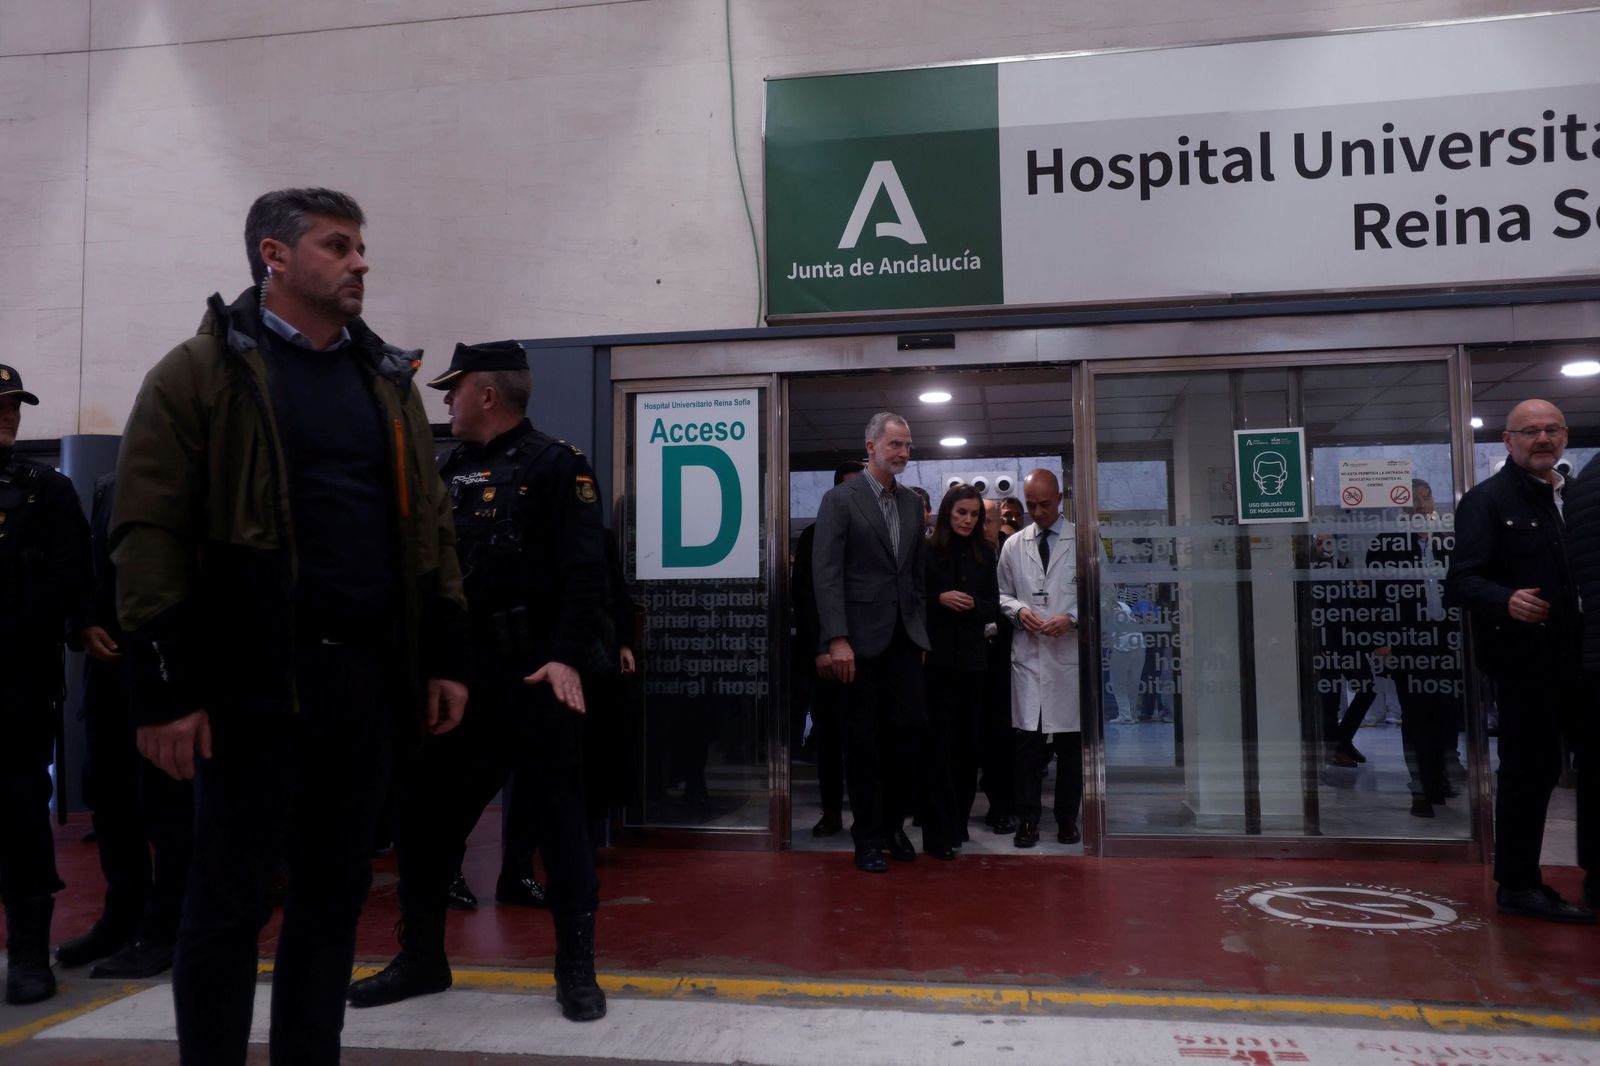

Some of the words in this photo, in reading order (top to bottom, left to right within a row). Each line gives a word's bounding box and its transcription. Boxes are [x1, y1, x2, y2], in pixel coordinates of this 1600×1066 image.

[1026, 131, 1276, 201] Hospital
[1293, 109, 1600, 180] Universit
[1353, 194, 1531, 251] Reina
[1552, 188, 1600, 239] S
[786, 262, 844, 280] Junta
[849, 258, 875, 277] de
[878, 249, 982, 275] Andalucía
[643, 401, 671, 411] Hospital
[671, 399, 713, 409] Universitario
[713, 399, 733, 407] Reina
[649, 417, 746, 444] Acceso
[661, 444, 743, 568] D
[1312, 579, 1377, 604] spital
[1311, 603, 1401, 627] general
[1341, 625, 1439, 650] hospital
[1371, 650, 1462, 674] general
